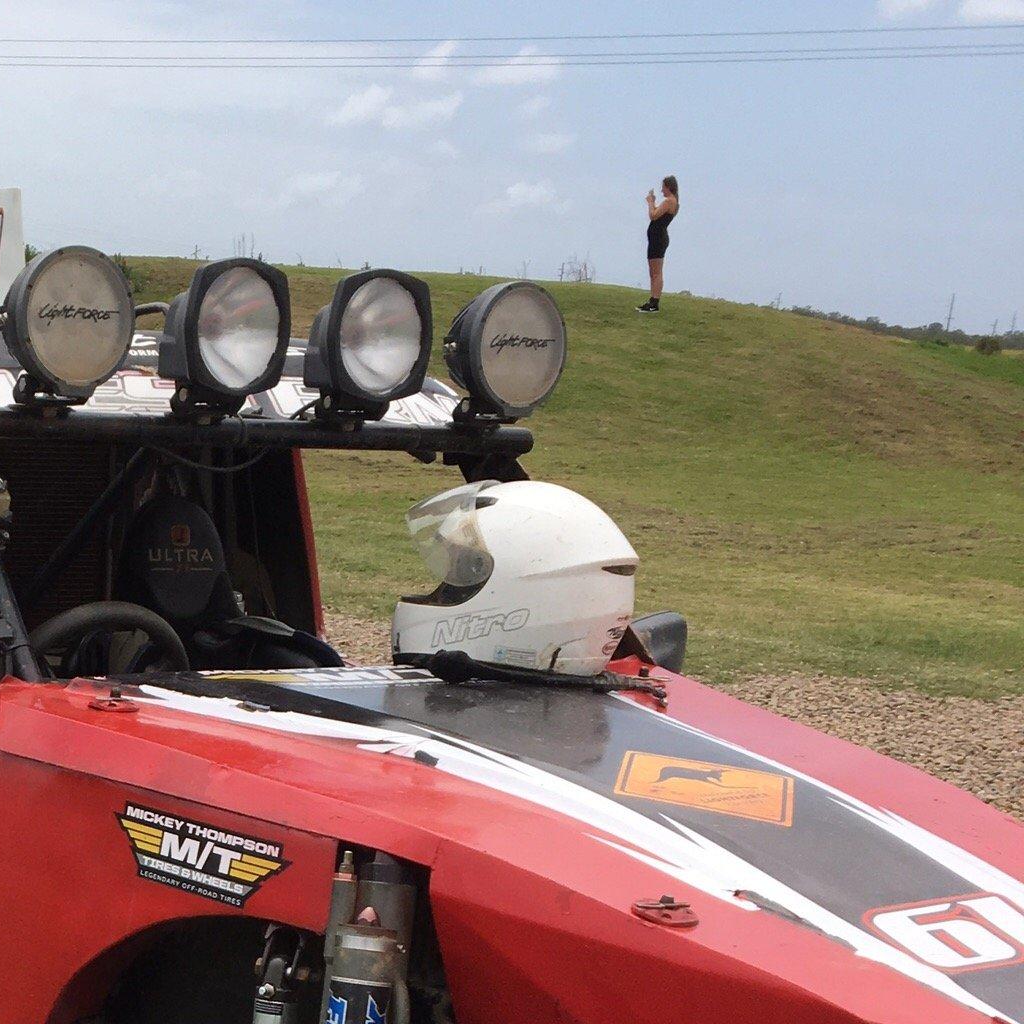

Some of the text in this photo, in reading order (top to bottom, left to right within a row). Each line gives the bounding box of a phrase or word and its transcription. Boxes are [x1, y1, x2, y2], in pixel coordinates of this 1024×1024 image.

[148, 549, 214, 562] ULTRA
[126, 805, 280, 858] MICKEY THOMPSON
[159, 832, 242, 875] M/T
[140, 870, 242, 906] LEGENDARY OFF-ROAD TIRES
[142, 857, 182, 877] TIRES
[190, 871, 245, 894] WHEELS
